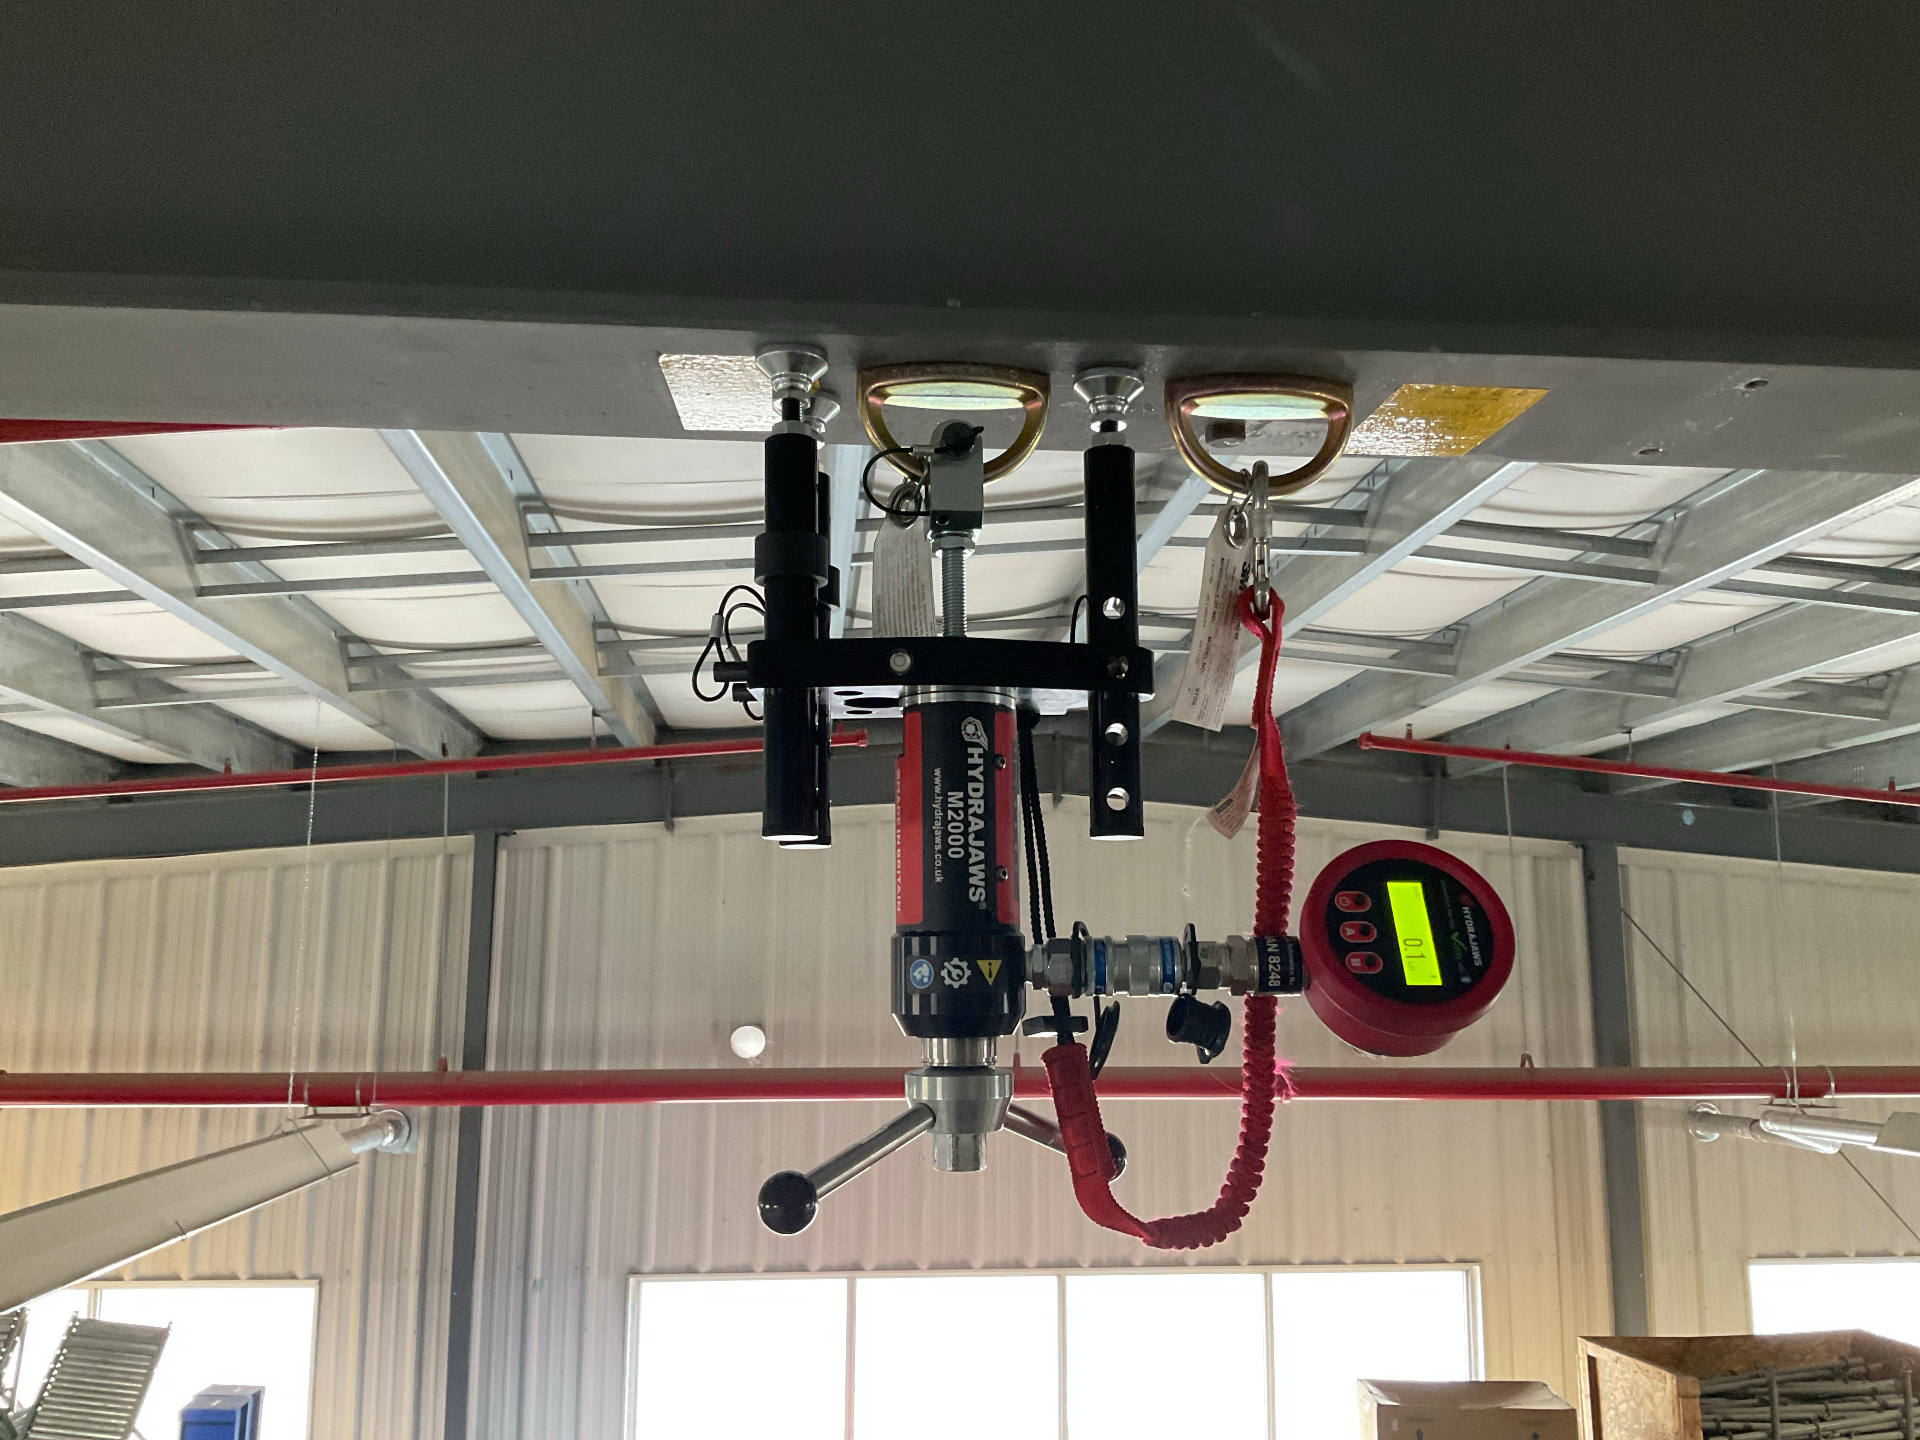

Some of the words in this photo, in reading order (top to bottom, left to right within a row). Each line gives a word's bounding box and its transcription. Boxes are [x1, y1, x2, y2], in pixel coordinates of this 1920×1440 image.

[932, 767, 943, 883] www.hydrajaws.co.uk
[947, 791, 965, 859] M2000
[1344, 927, 1354, 936] A
[1462, 906, 1483, 967] HYDRAJAWS
[1351, 958, 1361, 967] B
[1403, 938, 1427, 960] 0.1
[1267, 955, 1281, 987] 8248
